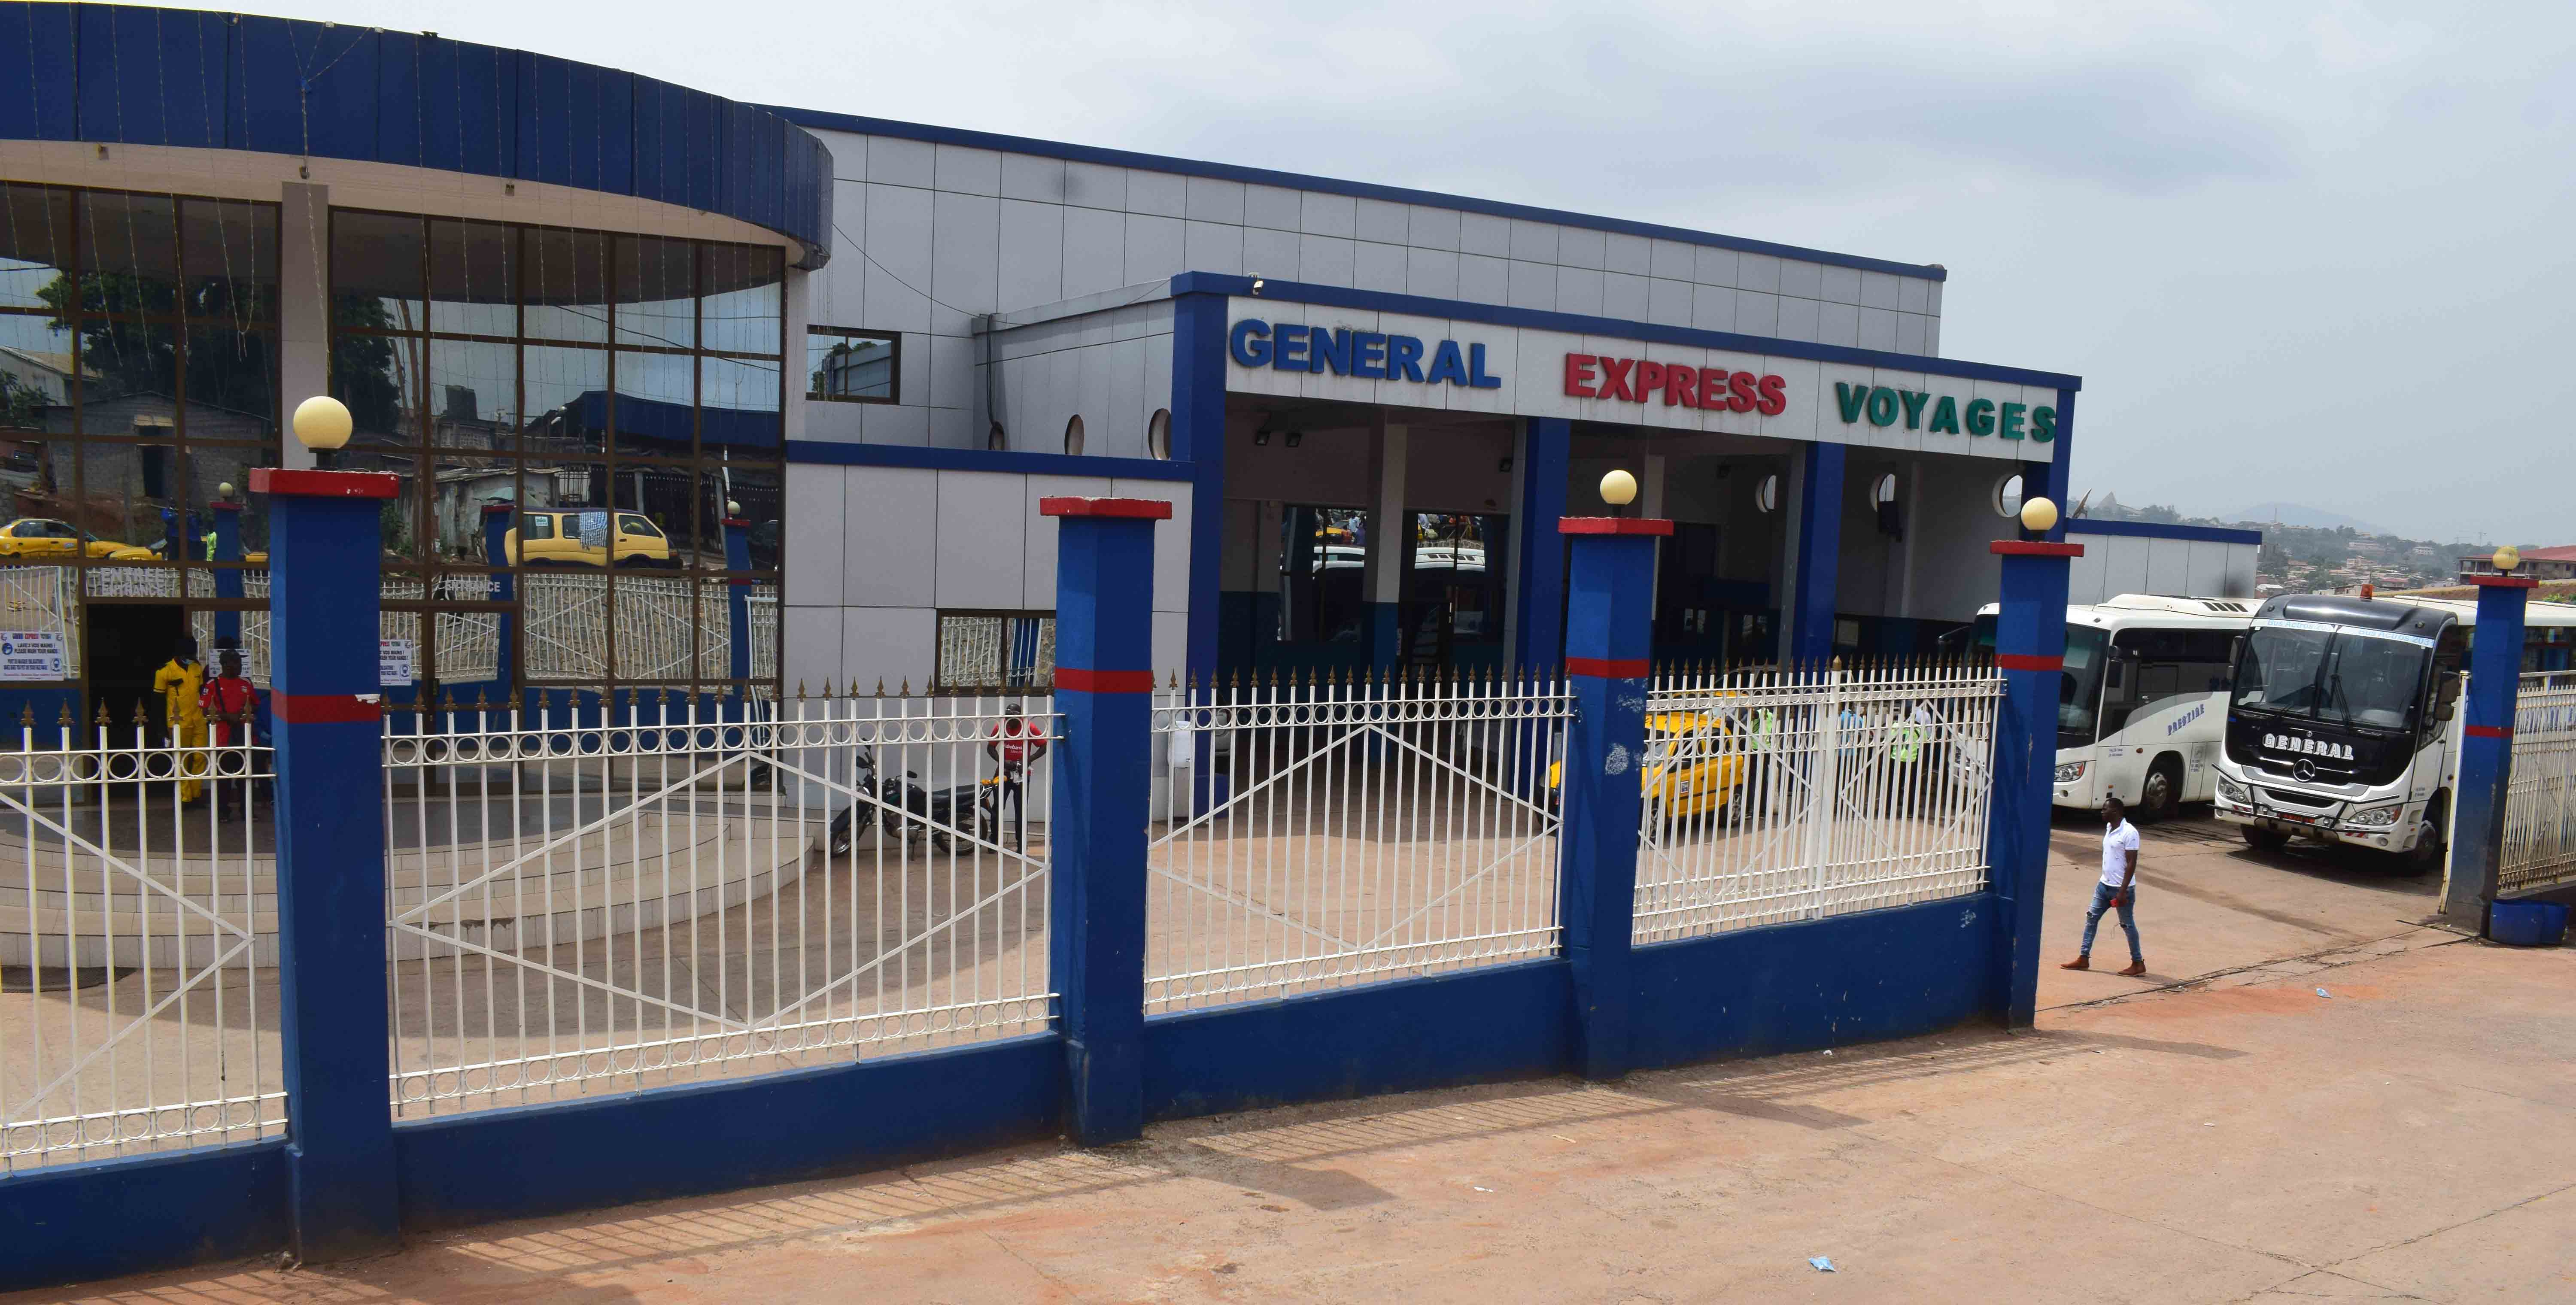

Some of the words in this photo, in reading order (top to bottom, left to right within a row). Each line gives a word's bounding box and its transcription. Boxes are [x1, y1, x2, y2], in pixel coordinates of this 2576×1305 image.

[1230, 319, 1501, 388] GENERAL
[1565, 353, 1786, 415] EXPRESS
[1835, 382, 2056, 443] VOYAGES
[445, 581, 501, 592] ENTRANCE
[2262, 733, 2354, 760] GENERAL
